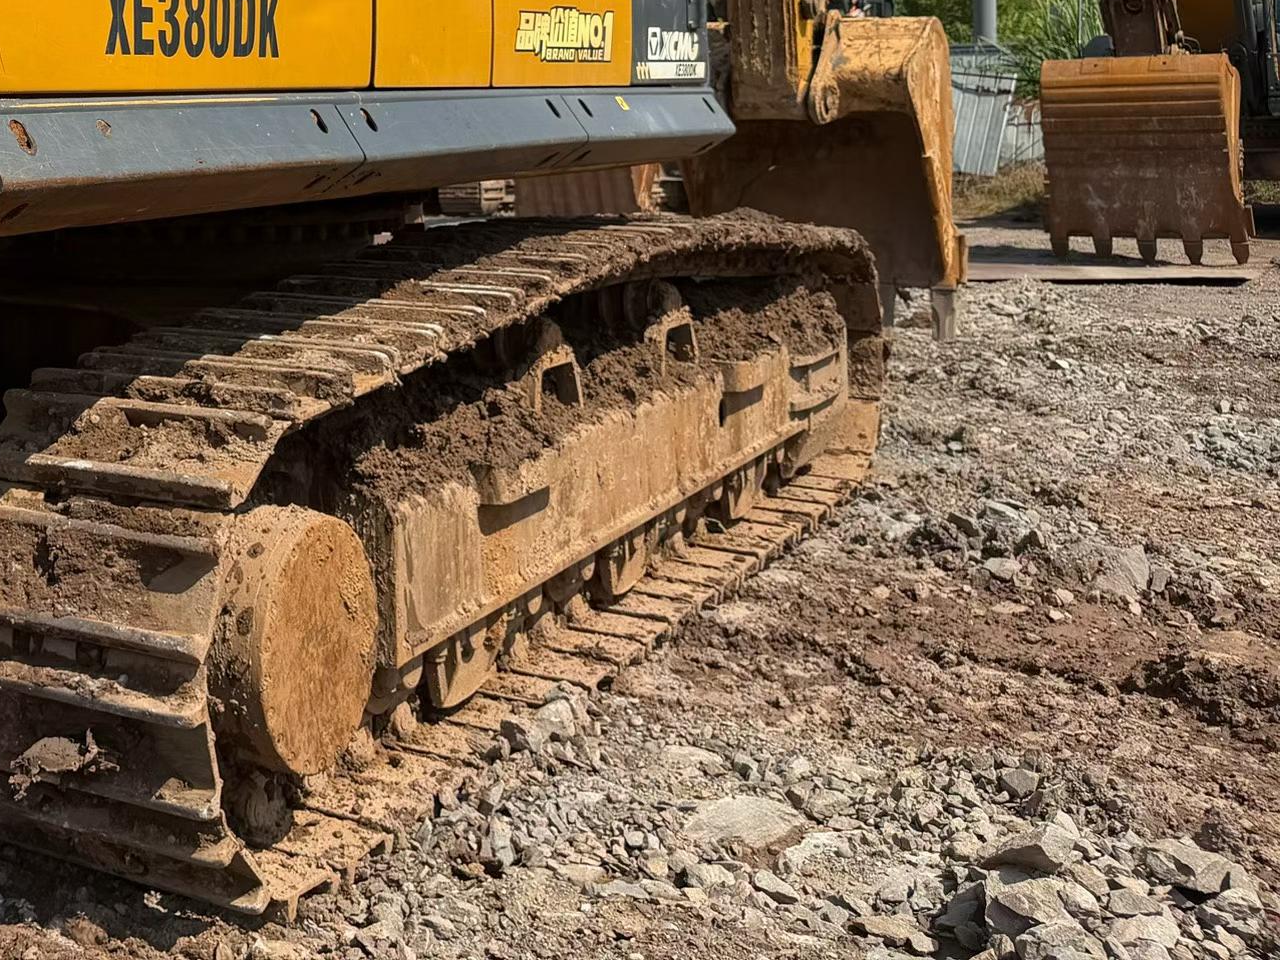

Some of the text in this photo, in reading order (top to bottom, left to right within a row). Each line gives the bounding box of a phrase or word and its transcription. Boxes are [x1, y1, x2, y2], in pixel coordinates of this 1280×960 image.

[546, 48, 604, 61] BRAND VALUE
[660, 30, 699, 61] XCMG
